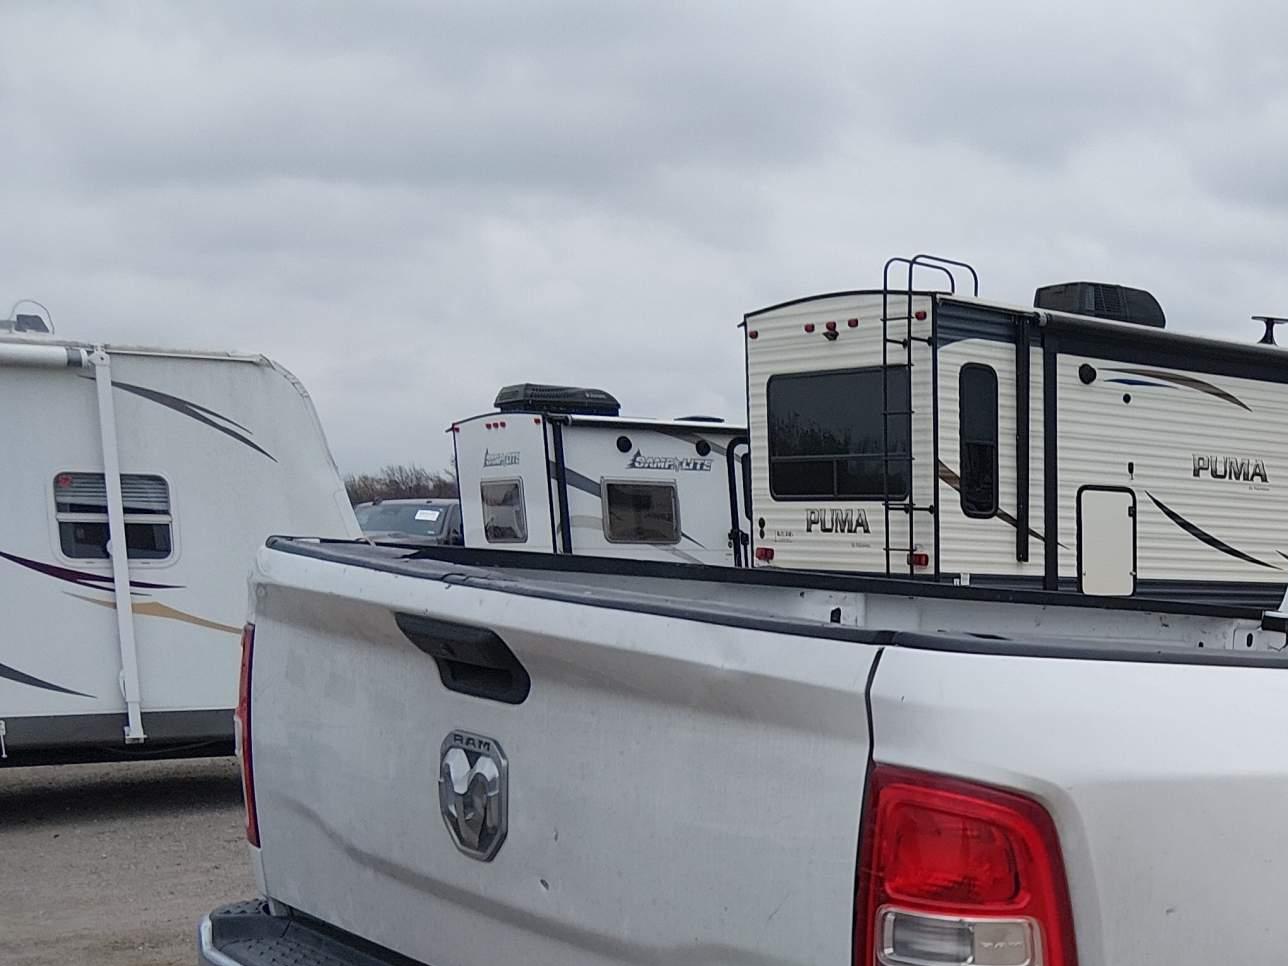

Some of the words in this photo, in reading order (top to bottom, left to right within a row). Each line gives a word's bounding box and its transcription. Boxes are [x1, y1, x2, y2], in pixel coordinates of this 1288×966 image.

[1192, 454, 1269, 483] PUMA
[806, 508, 870, 534] PUMA
[454, 734, 491, 751] RAM
